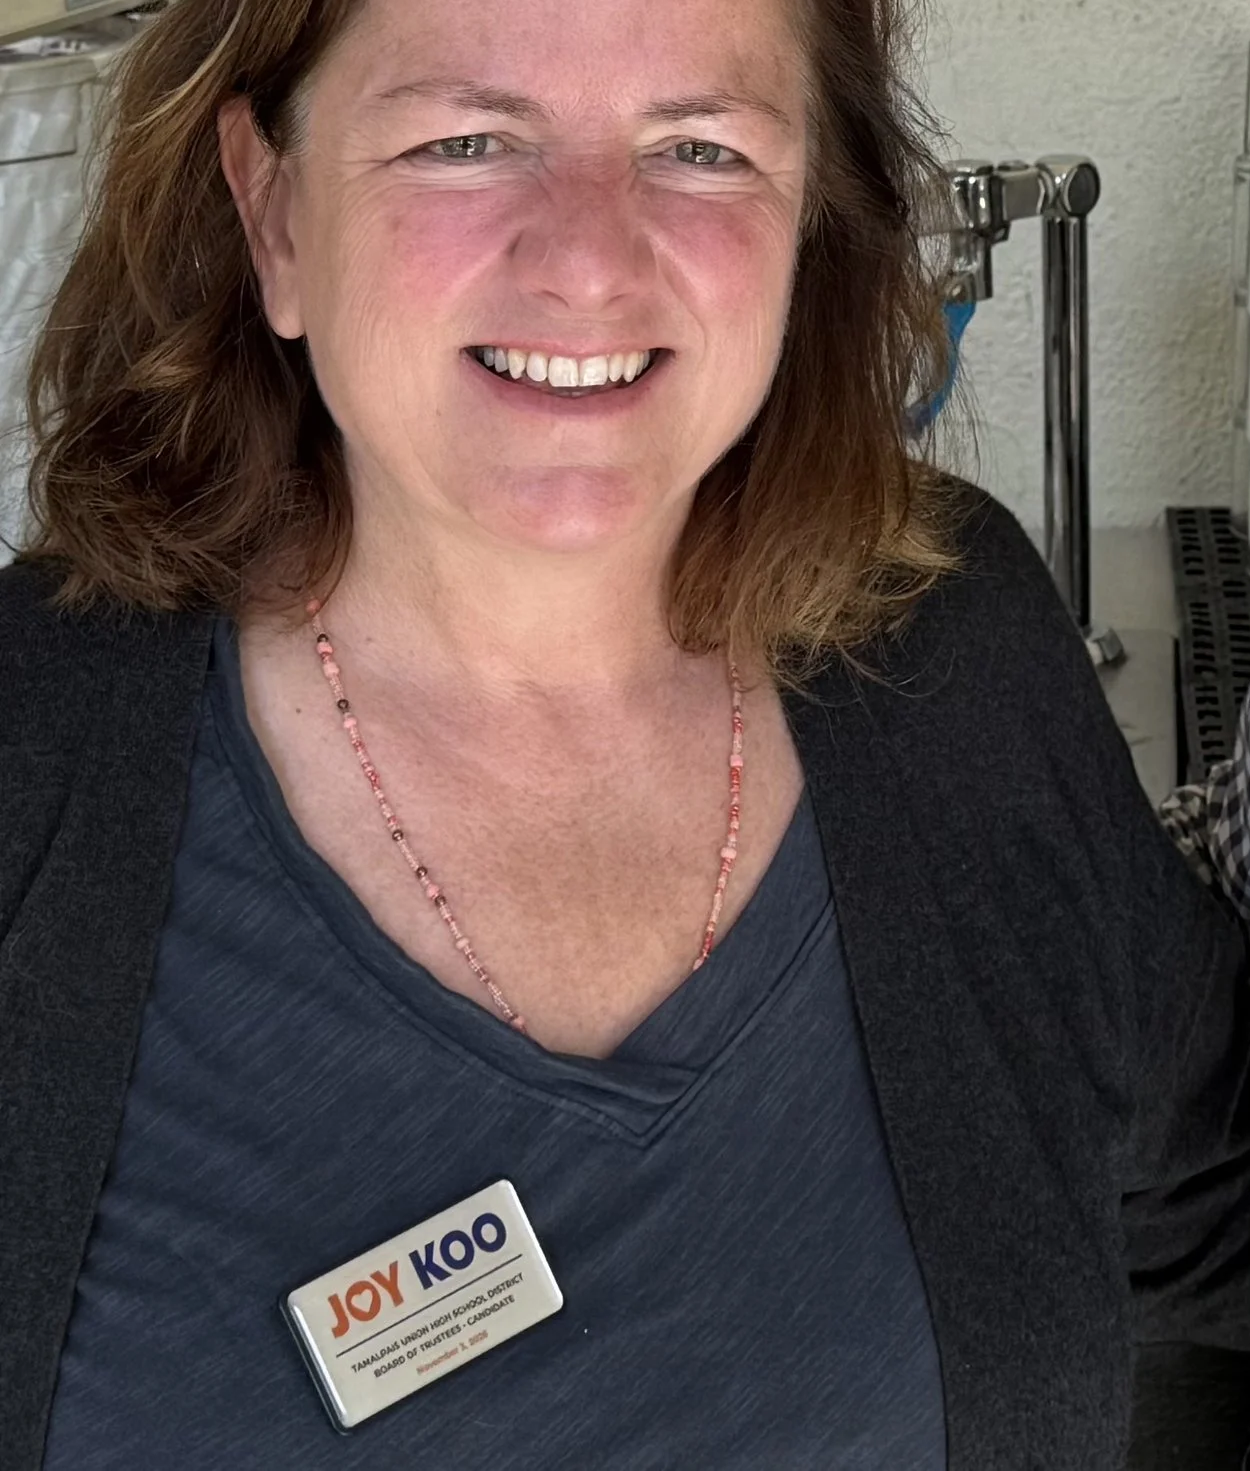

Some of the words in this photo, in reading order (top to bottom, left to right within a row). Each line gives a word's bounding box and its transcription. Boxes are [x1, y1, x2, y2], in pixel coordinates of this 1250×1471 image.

[327, 1260, 404, 1339] JOY
[408, 1212, 507, 1291] KOO
[351, 1341, 400, 1374] TAMALPAIS
[401, 1326, 430, 1346] UNION
[430, 1314, 452, 1331] HIGH
[452, 1295, 488, 1319] SCHOOL
[487, 1272, 524, 1298] DISTRICT
[373, 1354, 406, 1378] BOARD
[406, 1346, 418, 1359] OF
[419, 1324, 462, 1353] TRUSTEES
[467, 1294, 515, 1329] CANDIDATE
